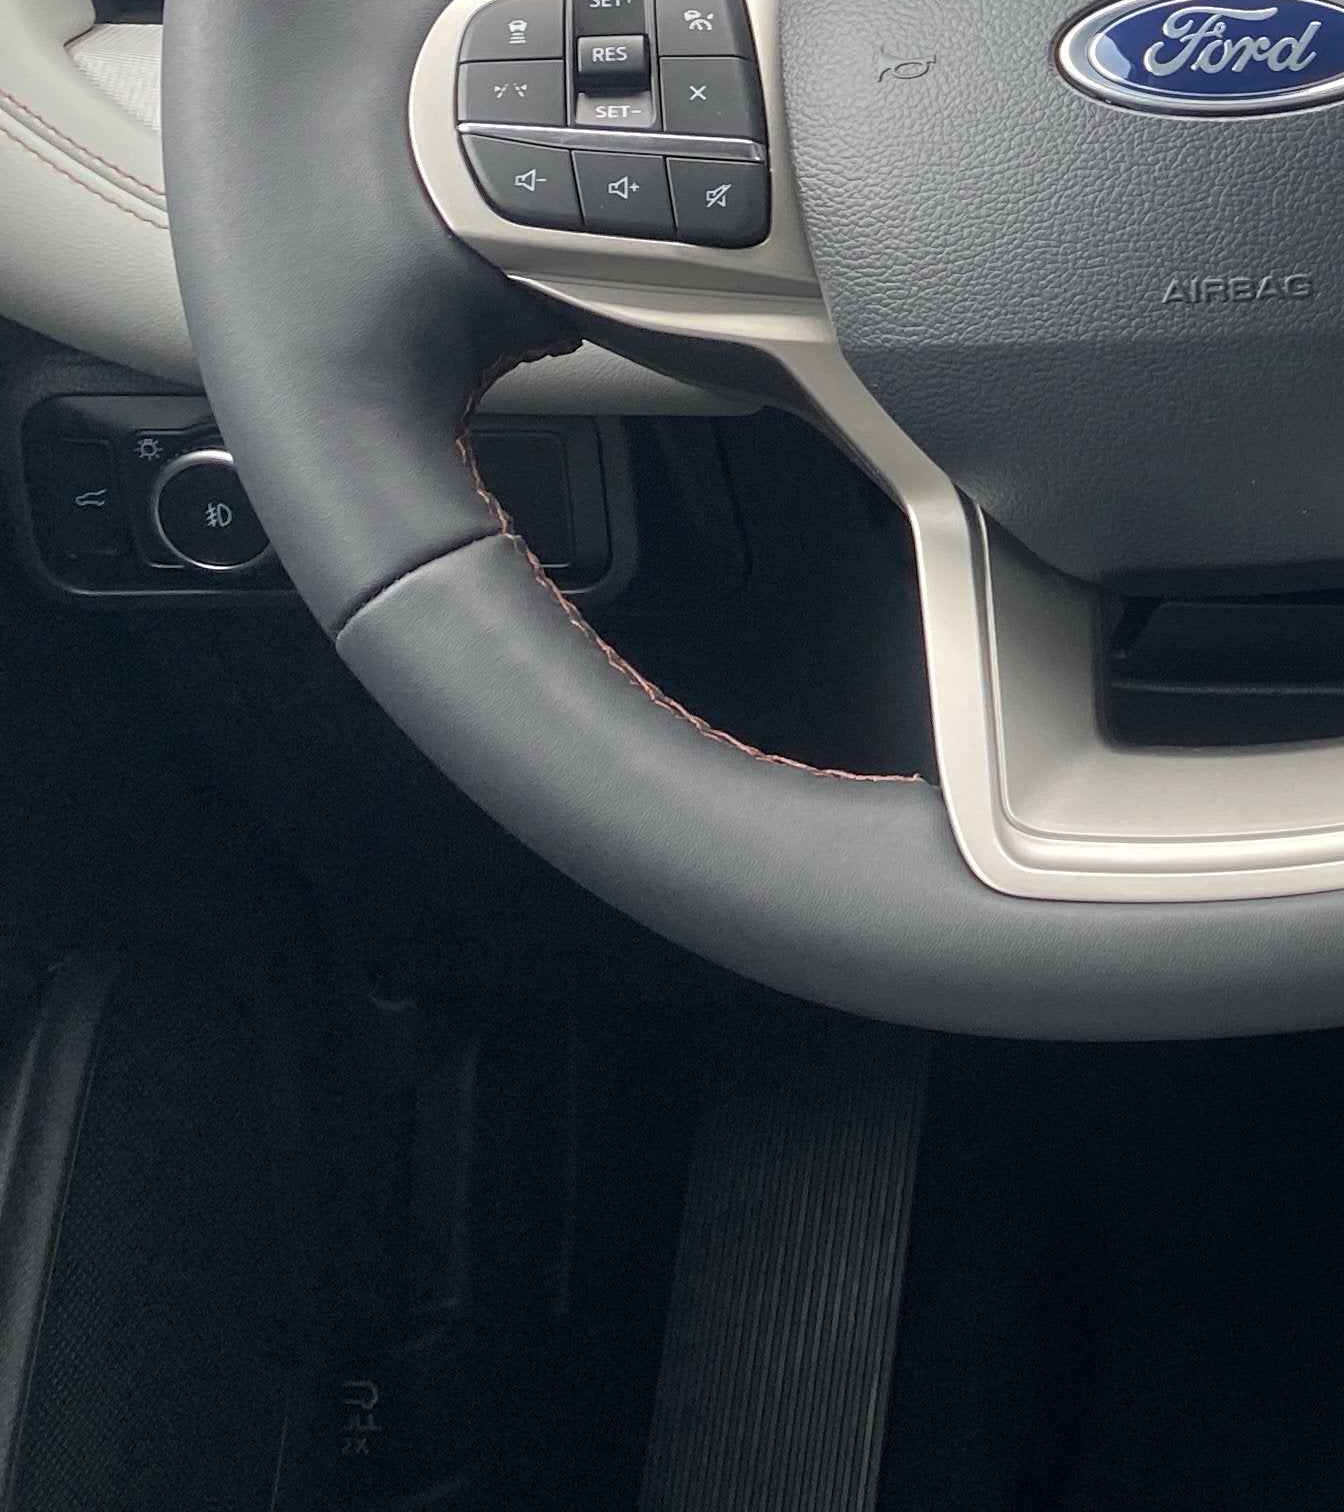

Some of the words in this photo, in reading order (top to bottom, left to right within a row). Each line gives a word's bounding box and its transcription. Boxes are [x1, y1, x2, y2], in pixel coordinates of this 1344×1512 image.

[592, 46, 628, 62] RES
[1143, 6, 1322, 77] Ford
[1162, 273, 1313, 303] AIRBAG
